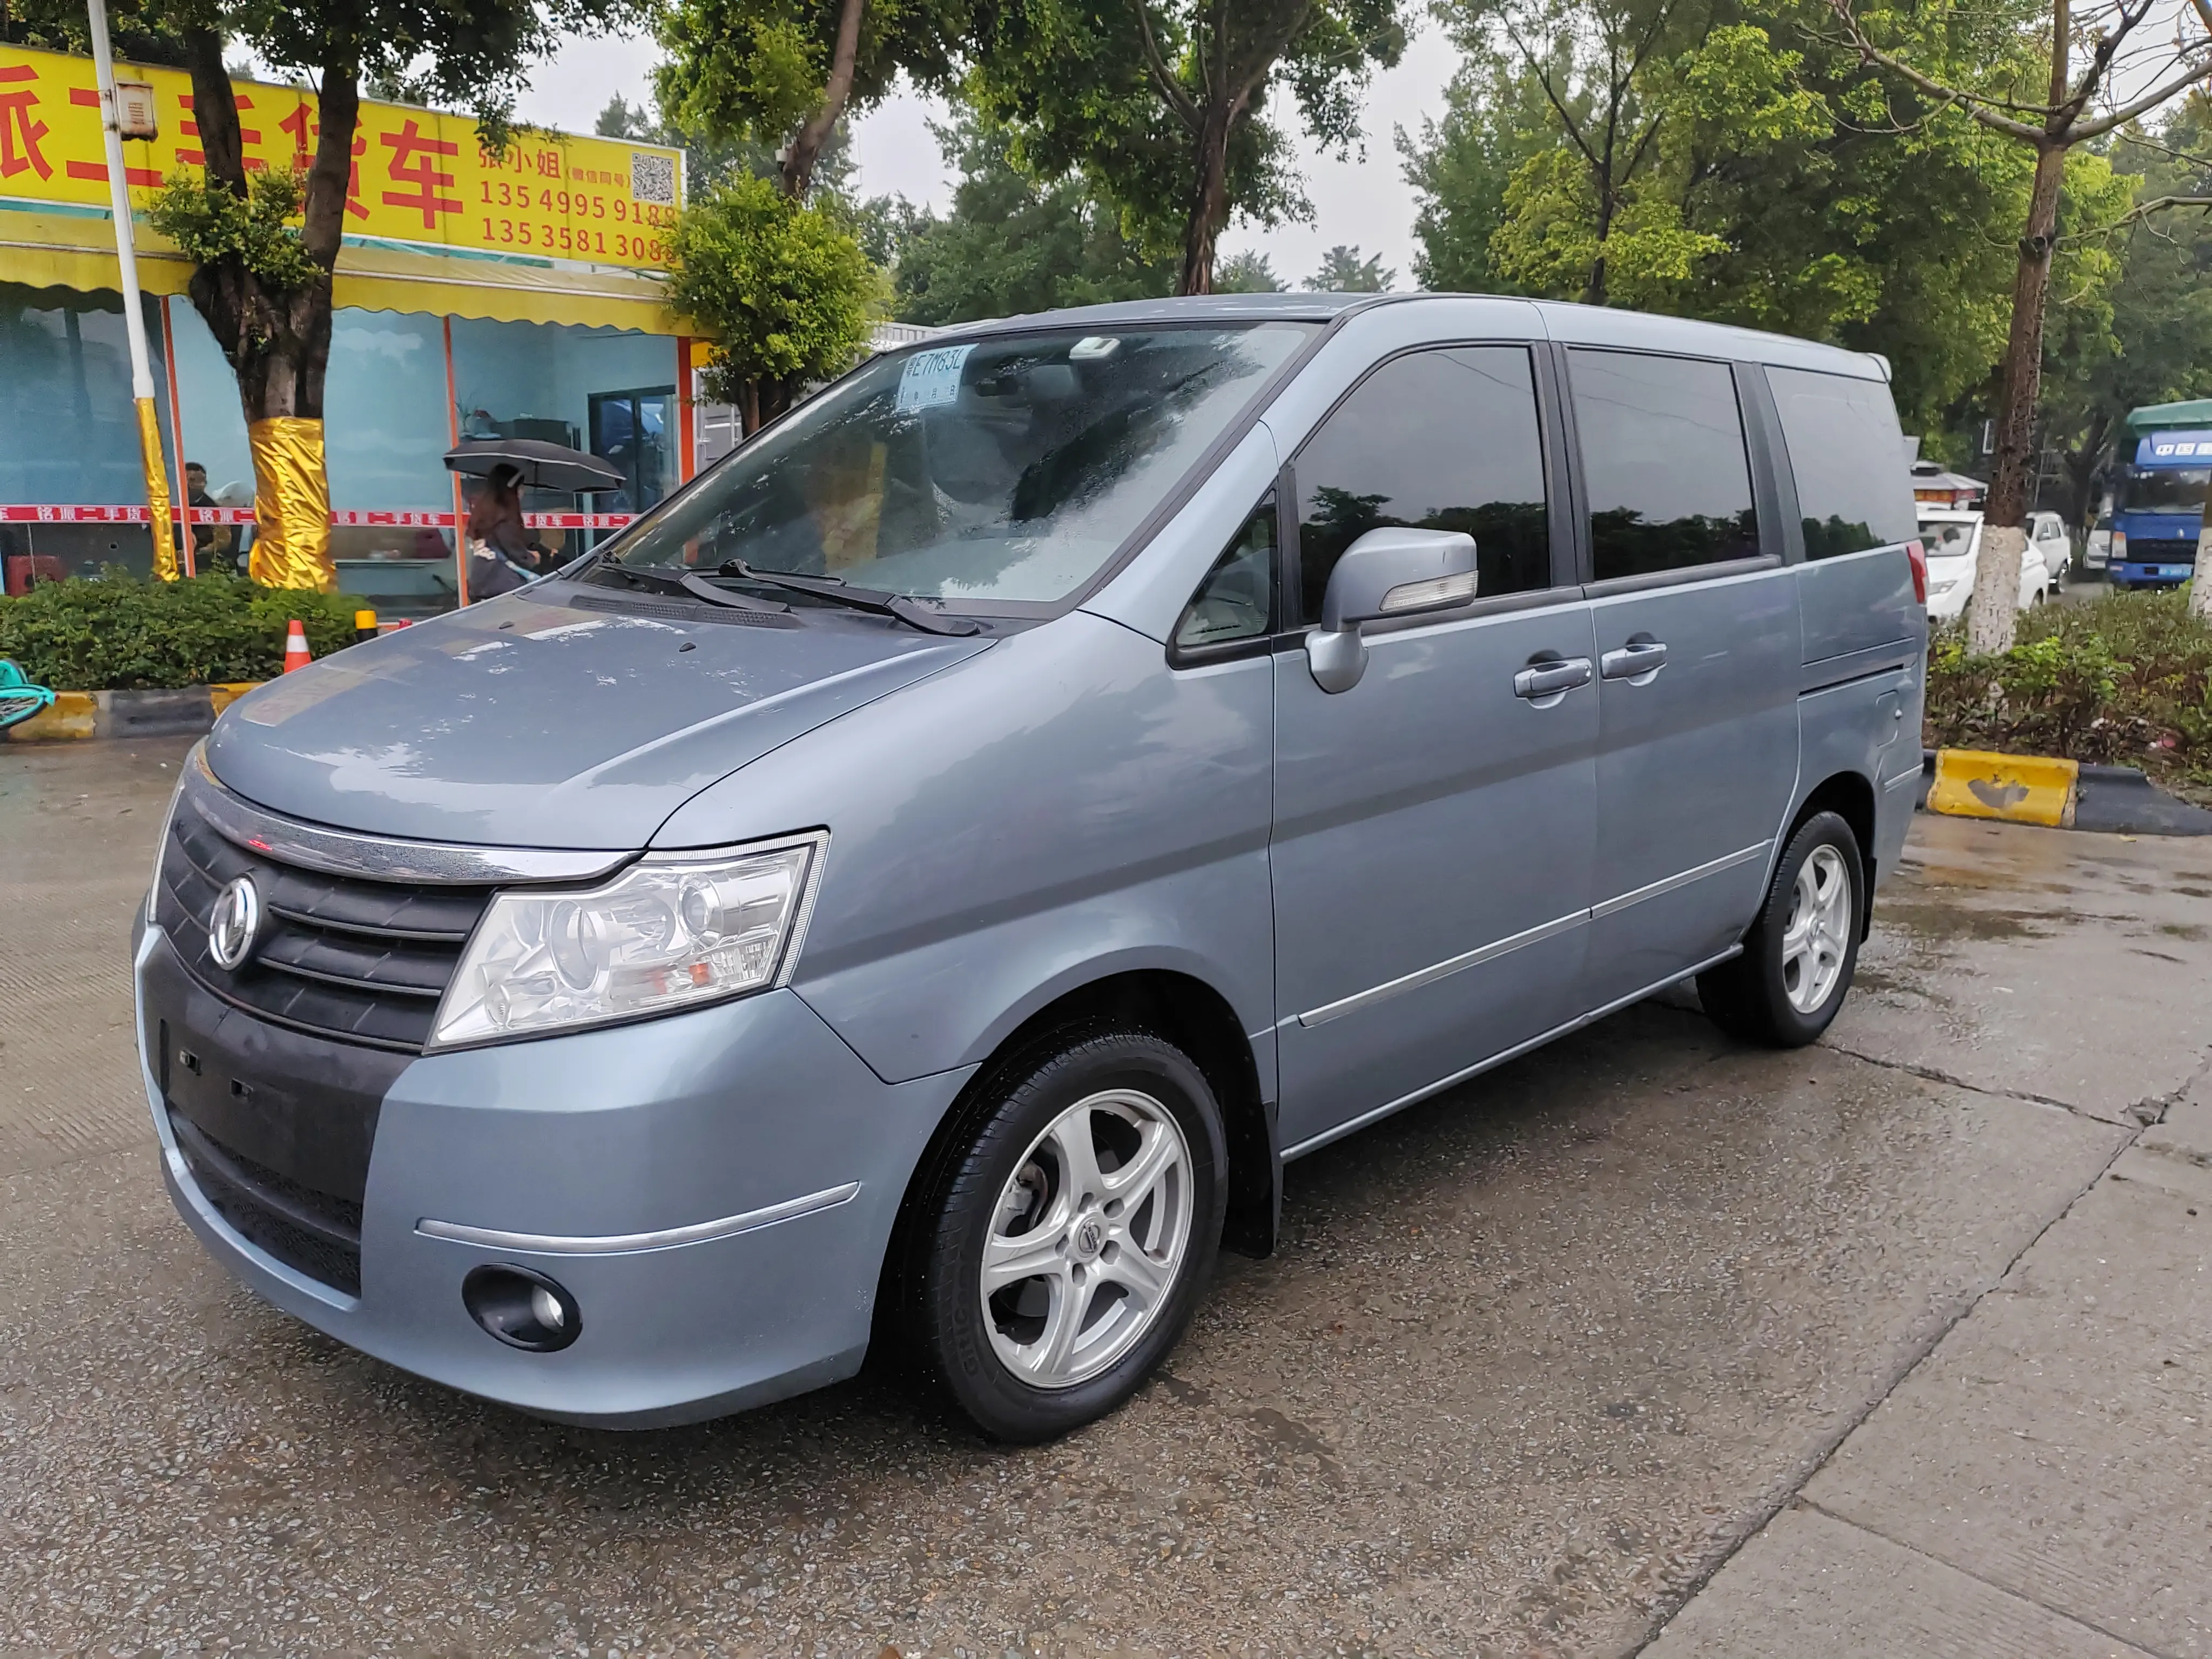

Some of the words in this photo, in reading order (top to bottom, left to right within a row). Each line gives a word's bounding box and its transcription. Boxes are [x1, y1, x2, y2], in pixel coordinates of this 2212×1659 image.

[480, 180, 530, 208] 135
[539, 189, 605, 219] 4995
[482, 217, 532, 245] 135
[542, 224, 606, 254] 3581
